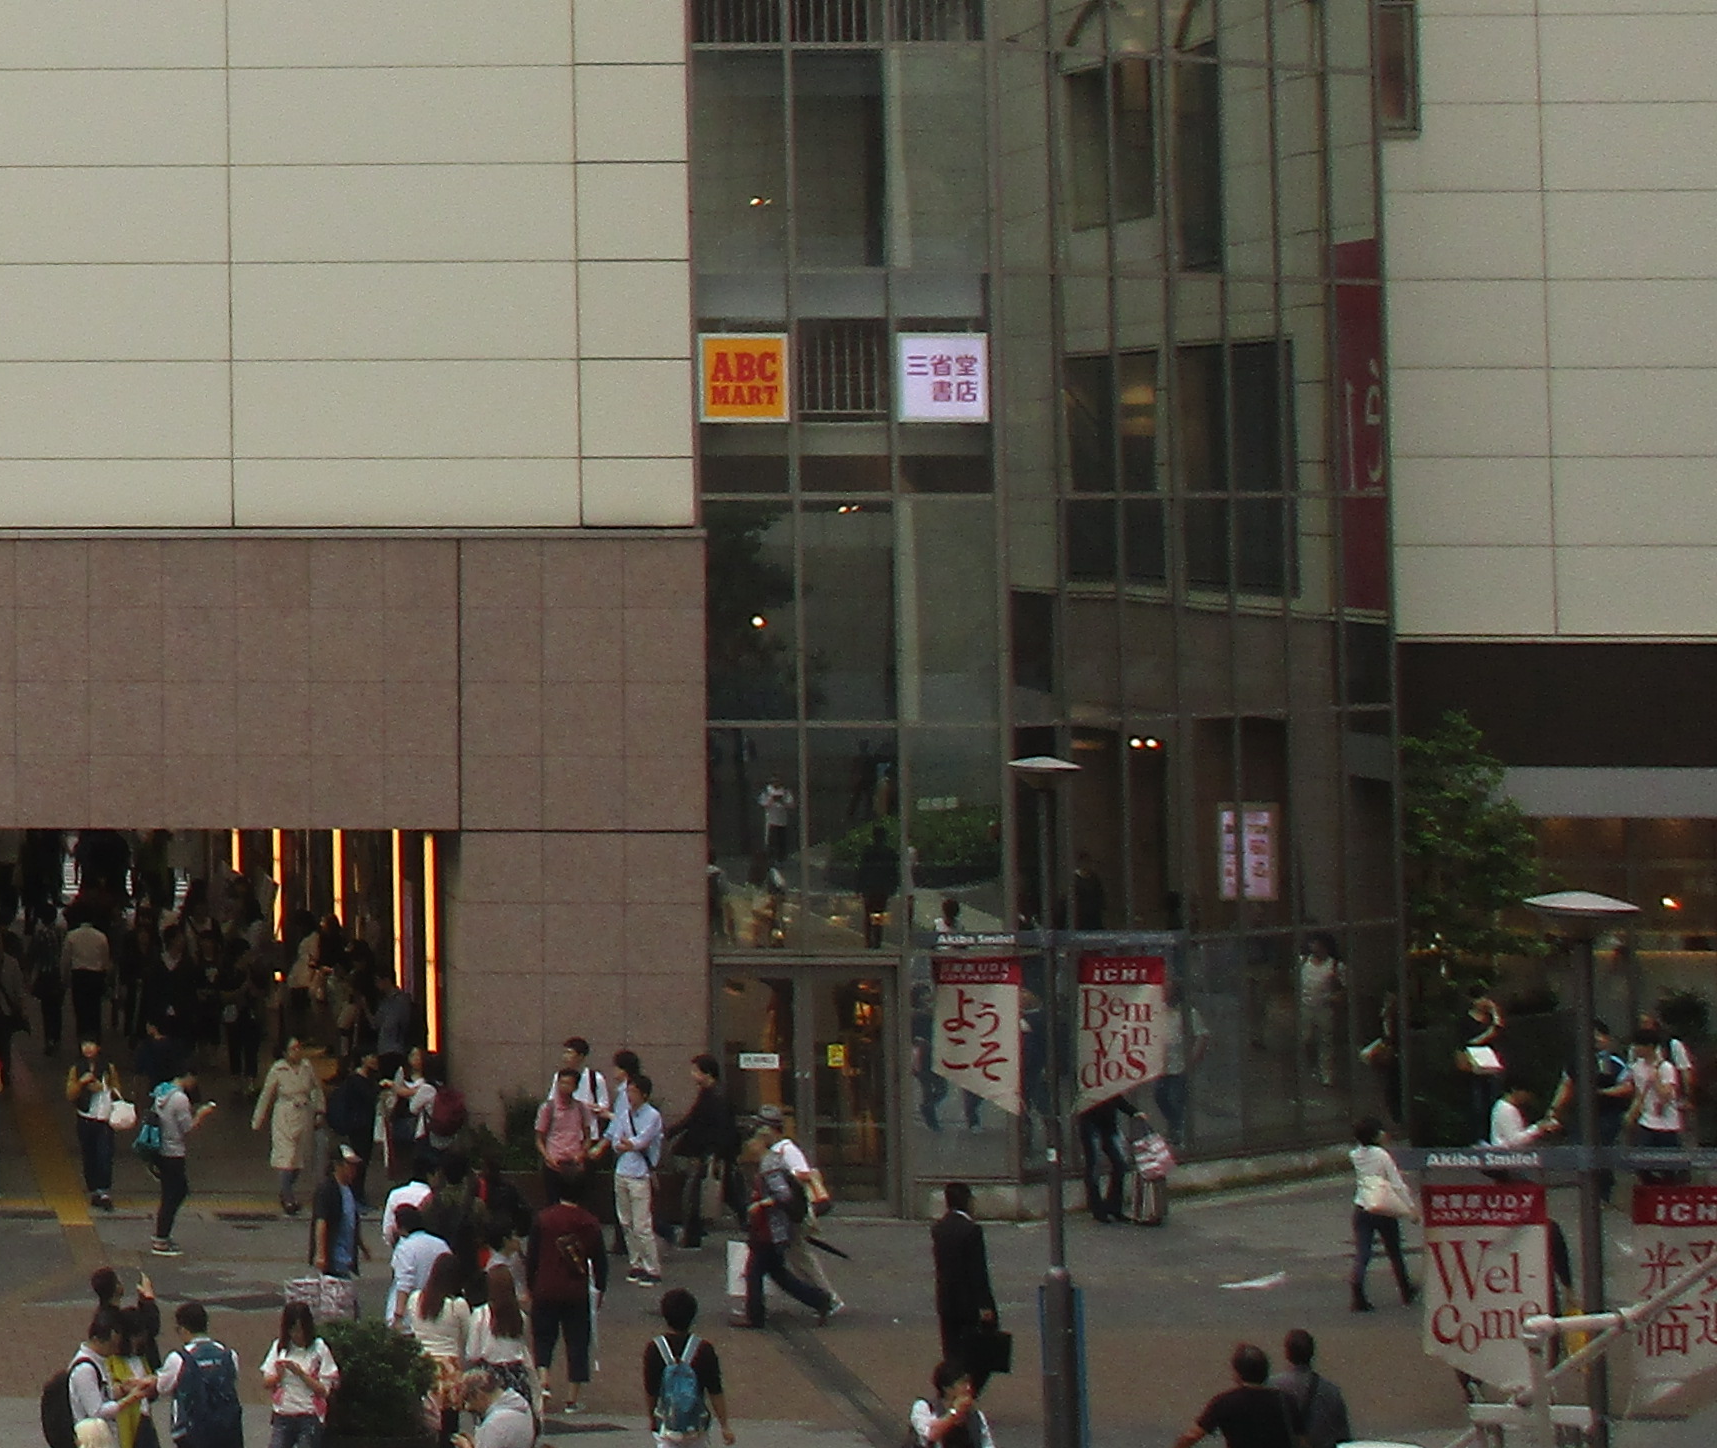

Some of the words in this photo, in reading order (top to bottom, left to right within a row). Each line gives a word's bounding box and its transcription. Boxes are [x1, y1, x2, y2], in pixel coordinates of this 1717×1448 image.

[711, 352, 777, 381] ABC
[907, 355, 977, 377] 三省堂
[710, 385, 778, 405] MART
[932, 381, 977, 402] 書店
[1093, 968, 1147, 981] ICHI
[1426, 1153, 1481, 1166] Akiba
